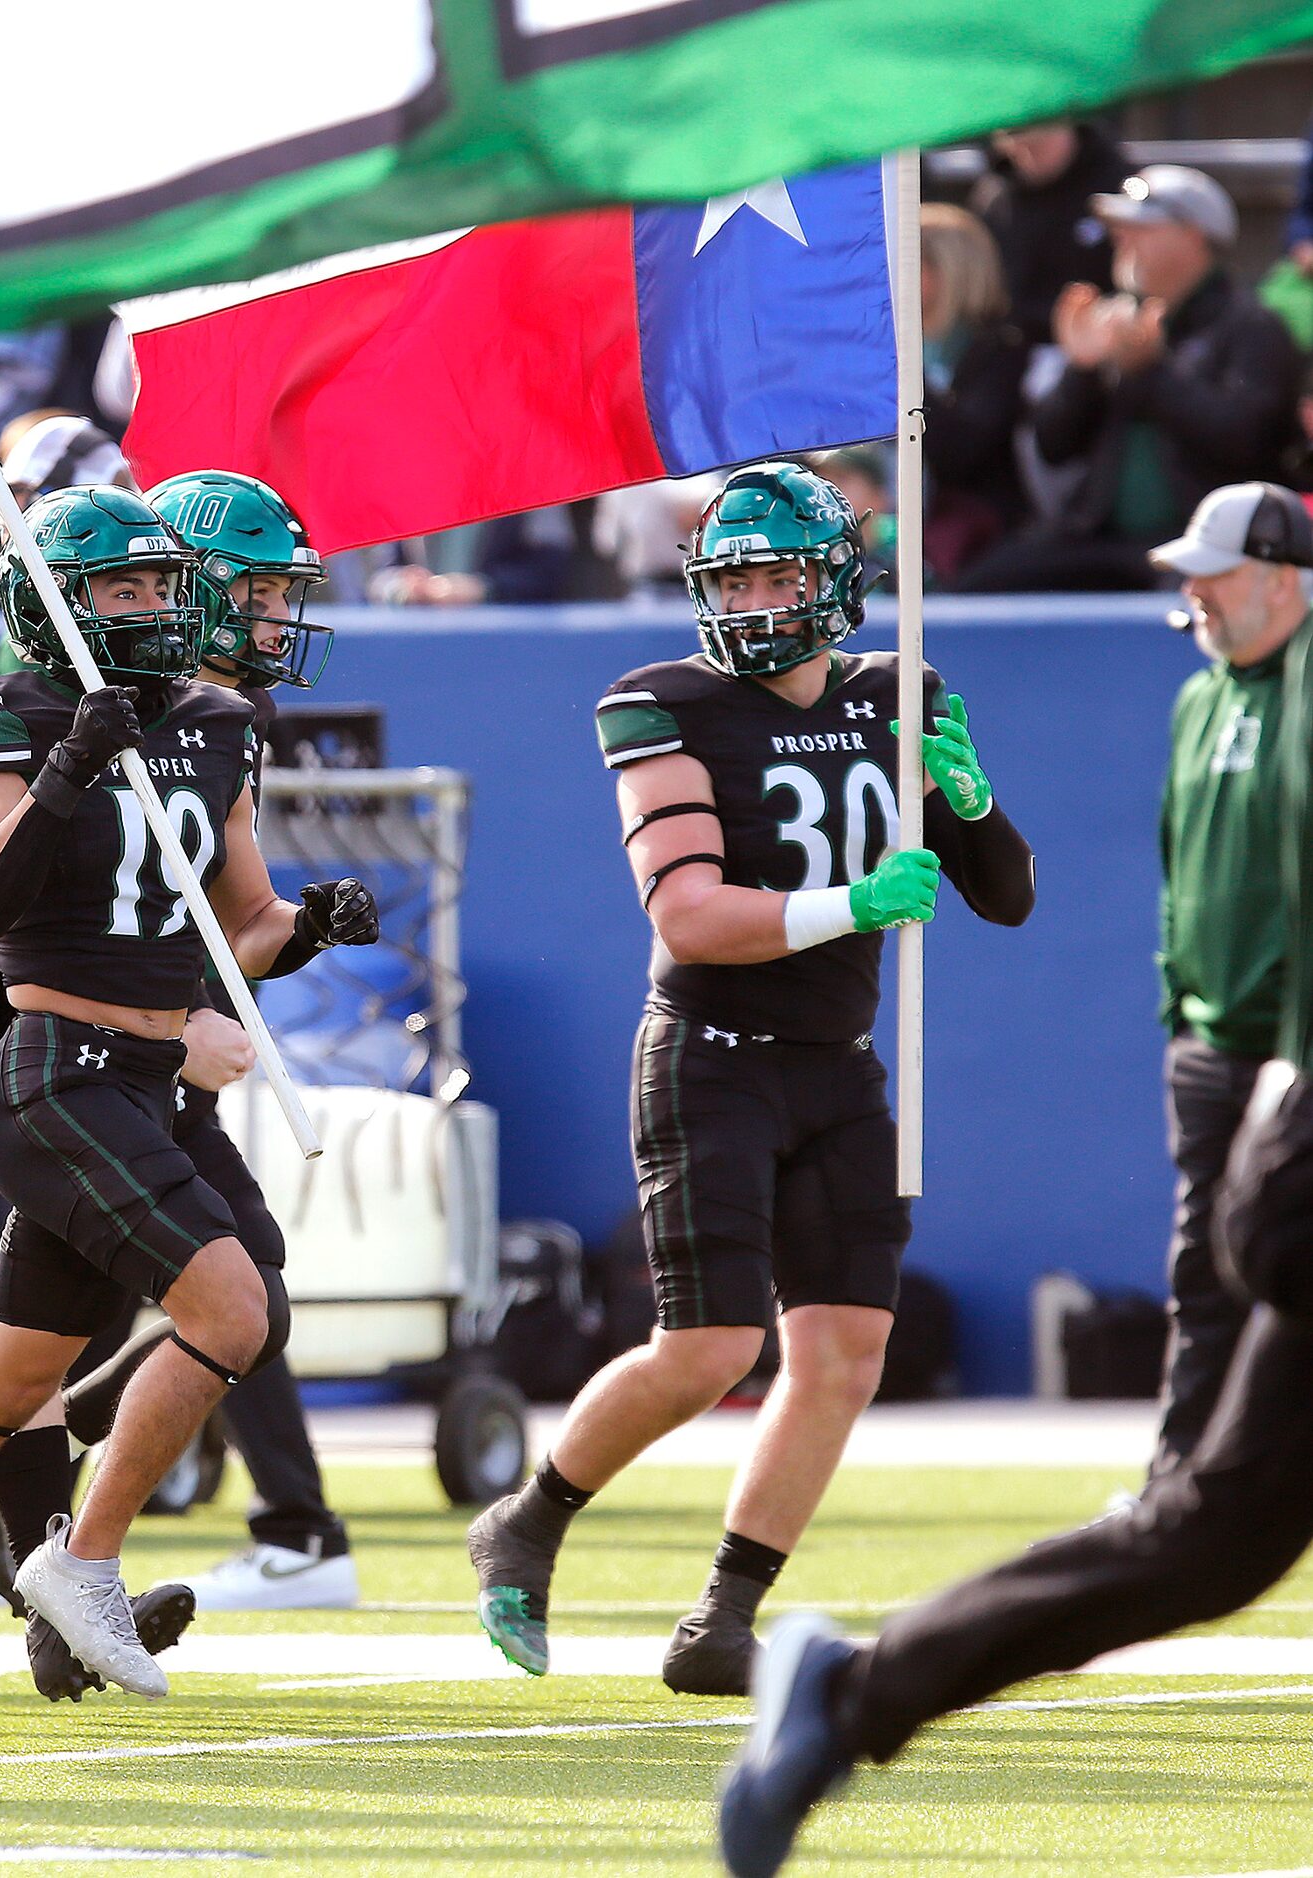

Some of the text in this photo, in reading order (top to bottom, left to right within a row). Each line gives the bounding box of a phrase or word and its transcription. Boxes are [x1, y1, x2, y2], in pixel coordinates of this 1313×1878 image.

[174, 489, 235, 539] 10
[110, 757, 197, 778] PSPER
[771, 731, 868, 754] PROSPER
[762, 759, 900, 893] 30
[102, 785, 217, 940] 19
